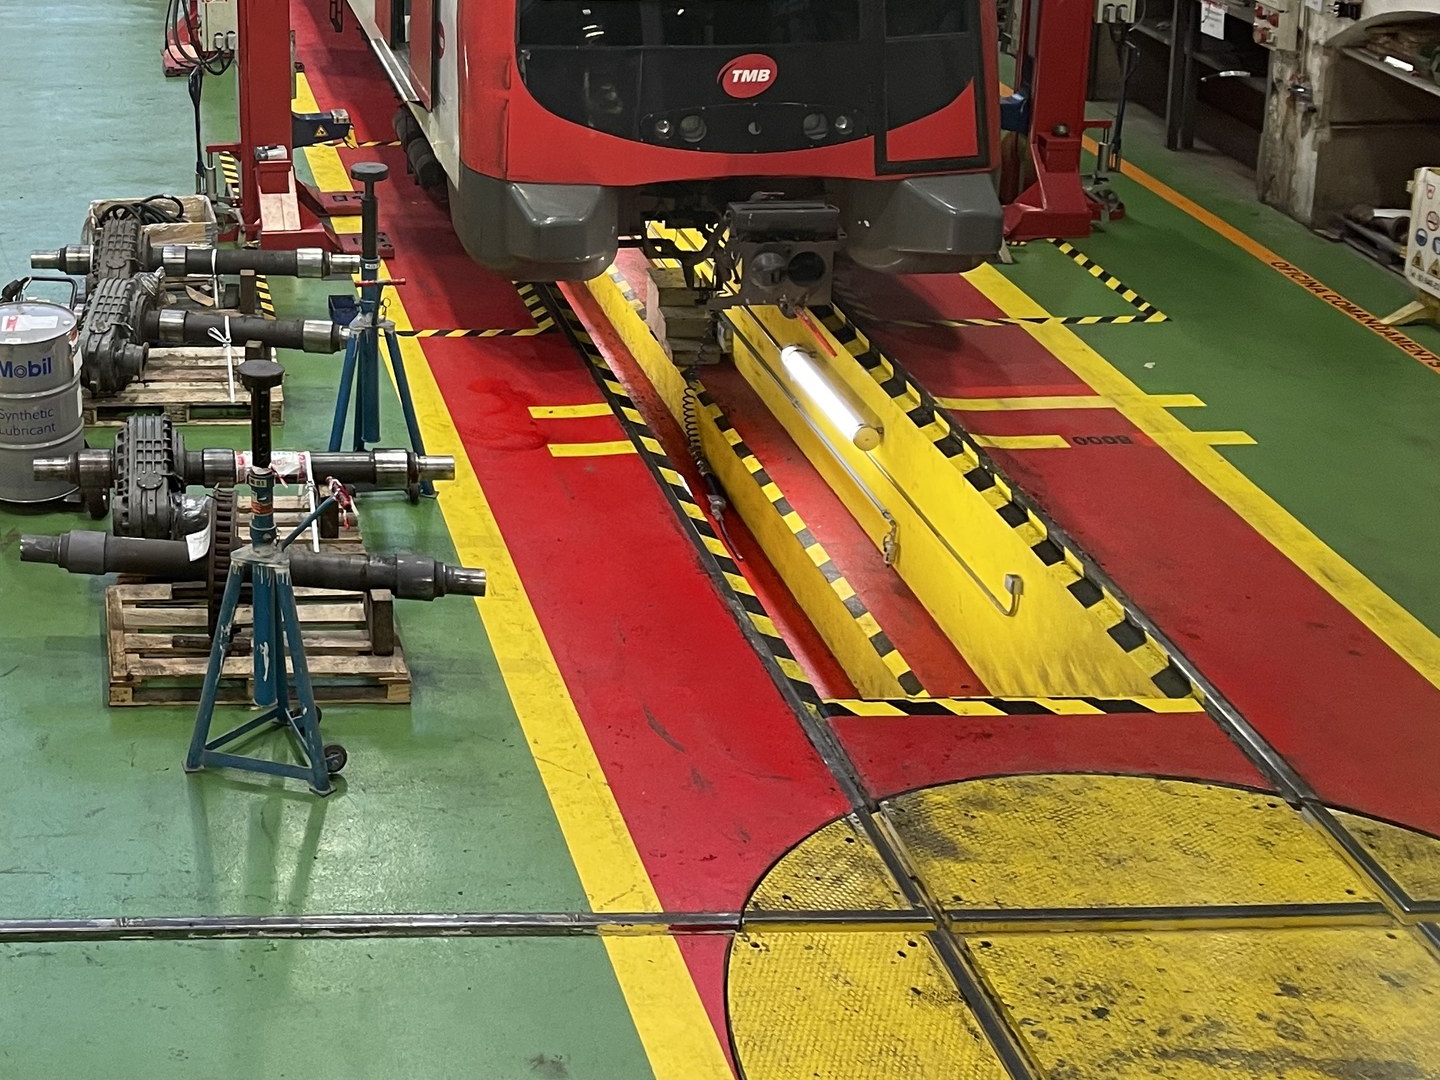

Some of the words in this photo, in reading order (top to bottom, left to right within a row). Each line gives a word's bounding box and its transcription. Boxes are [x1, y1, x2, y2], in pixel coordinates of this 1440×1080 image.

[732, 69, 771, 83] TMB
[1271, 261, 1325, 294] OFICINA
[0, 422, 56, 436] Lubricant
